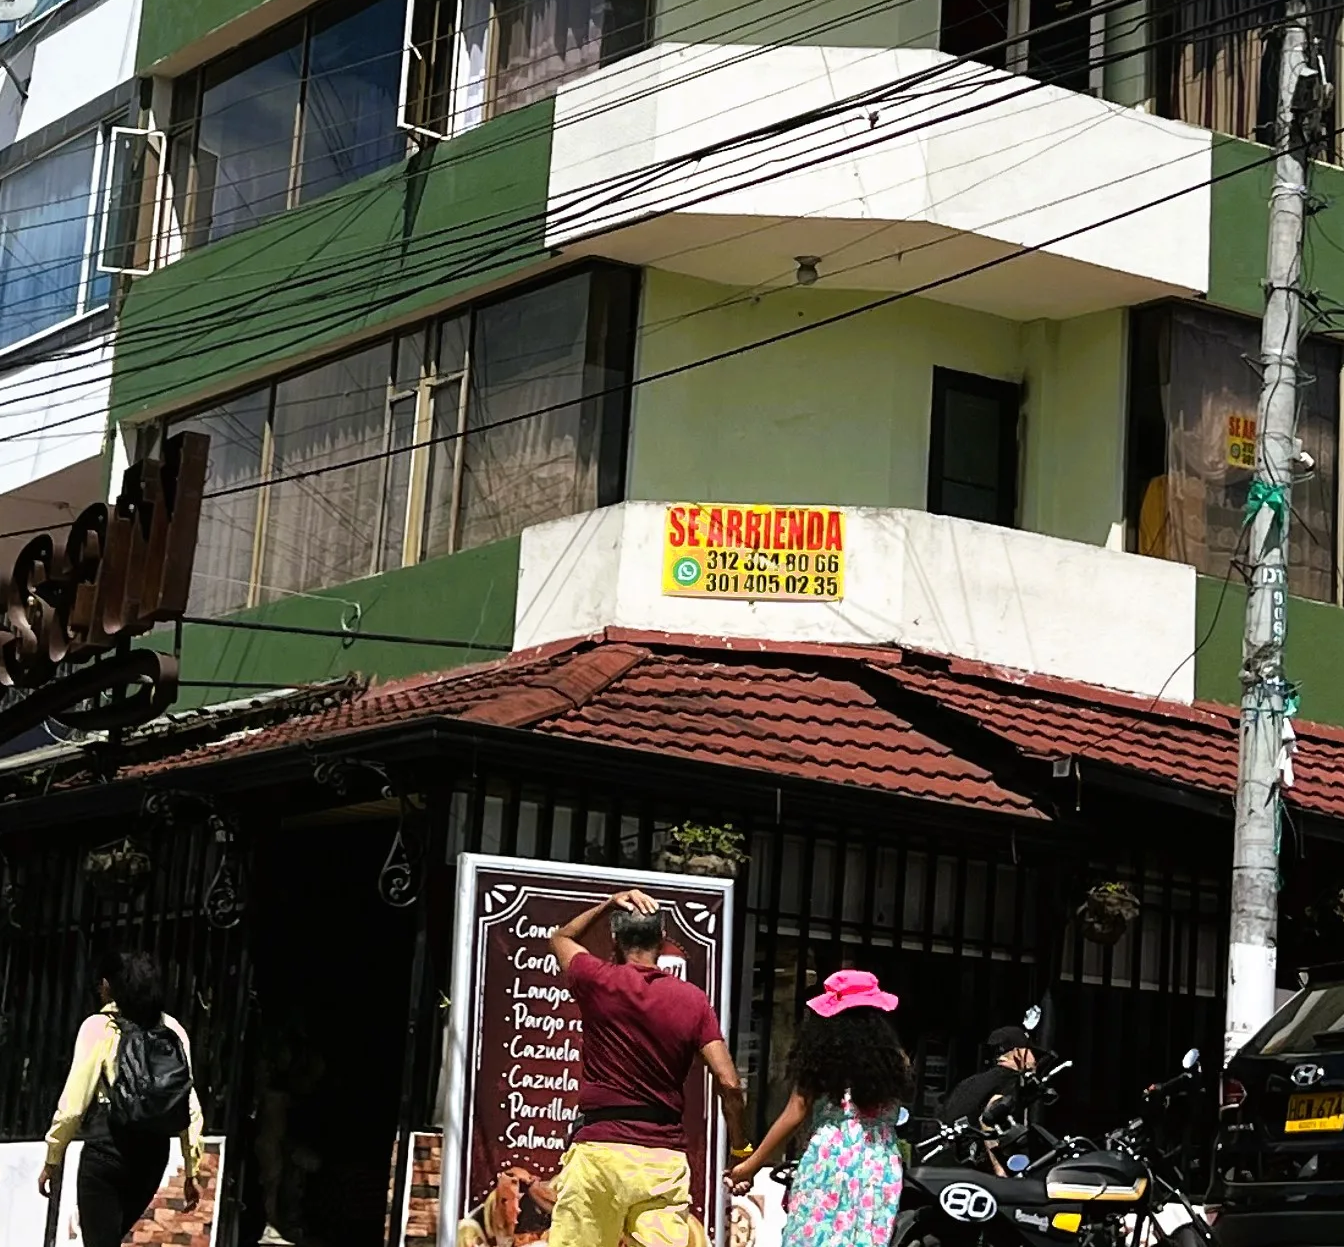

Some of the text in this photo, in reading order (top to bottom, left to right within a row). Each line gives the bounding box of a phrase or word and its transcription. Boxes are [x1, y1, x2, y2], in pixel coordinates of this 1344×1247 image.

[1228, 416, 1240, 437] SE
[669, 507, 843, 551] SE ARRIENDA
[707, 550, 738, 570] 312
[786, 553, 808, 572] 80
[815, 555, 839, 573] 66
[706, 573, 838, 595] 301 405 02 35
[512, 1003, 563, 1039] Pargo
[510, 1034, 580, 1061] Cazuela
[508, 1064, 579, 1091] Cazuela
[506, 1122, 565, 1149] Salmón
[946, 1188, 992, 1218] 80
